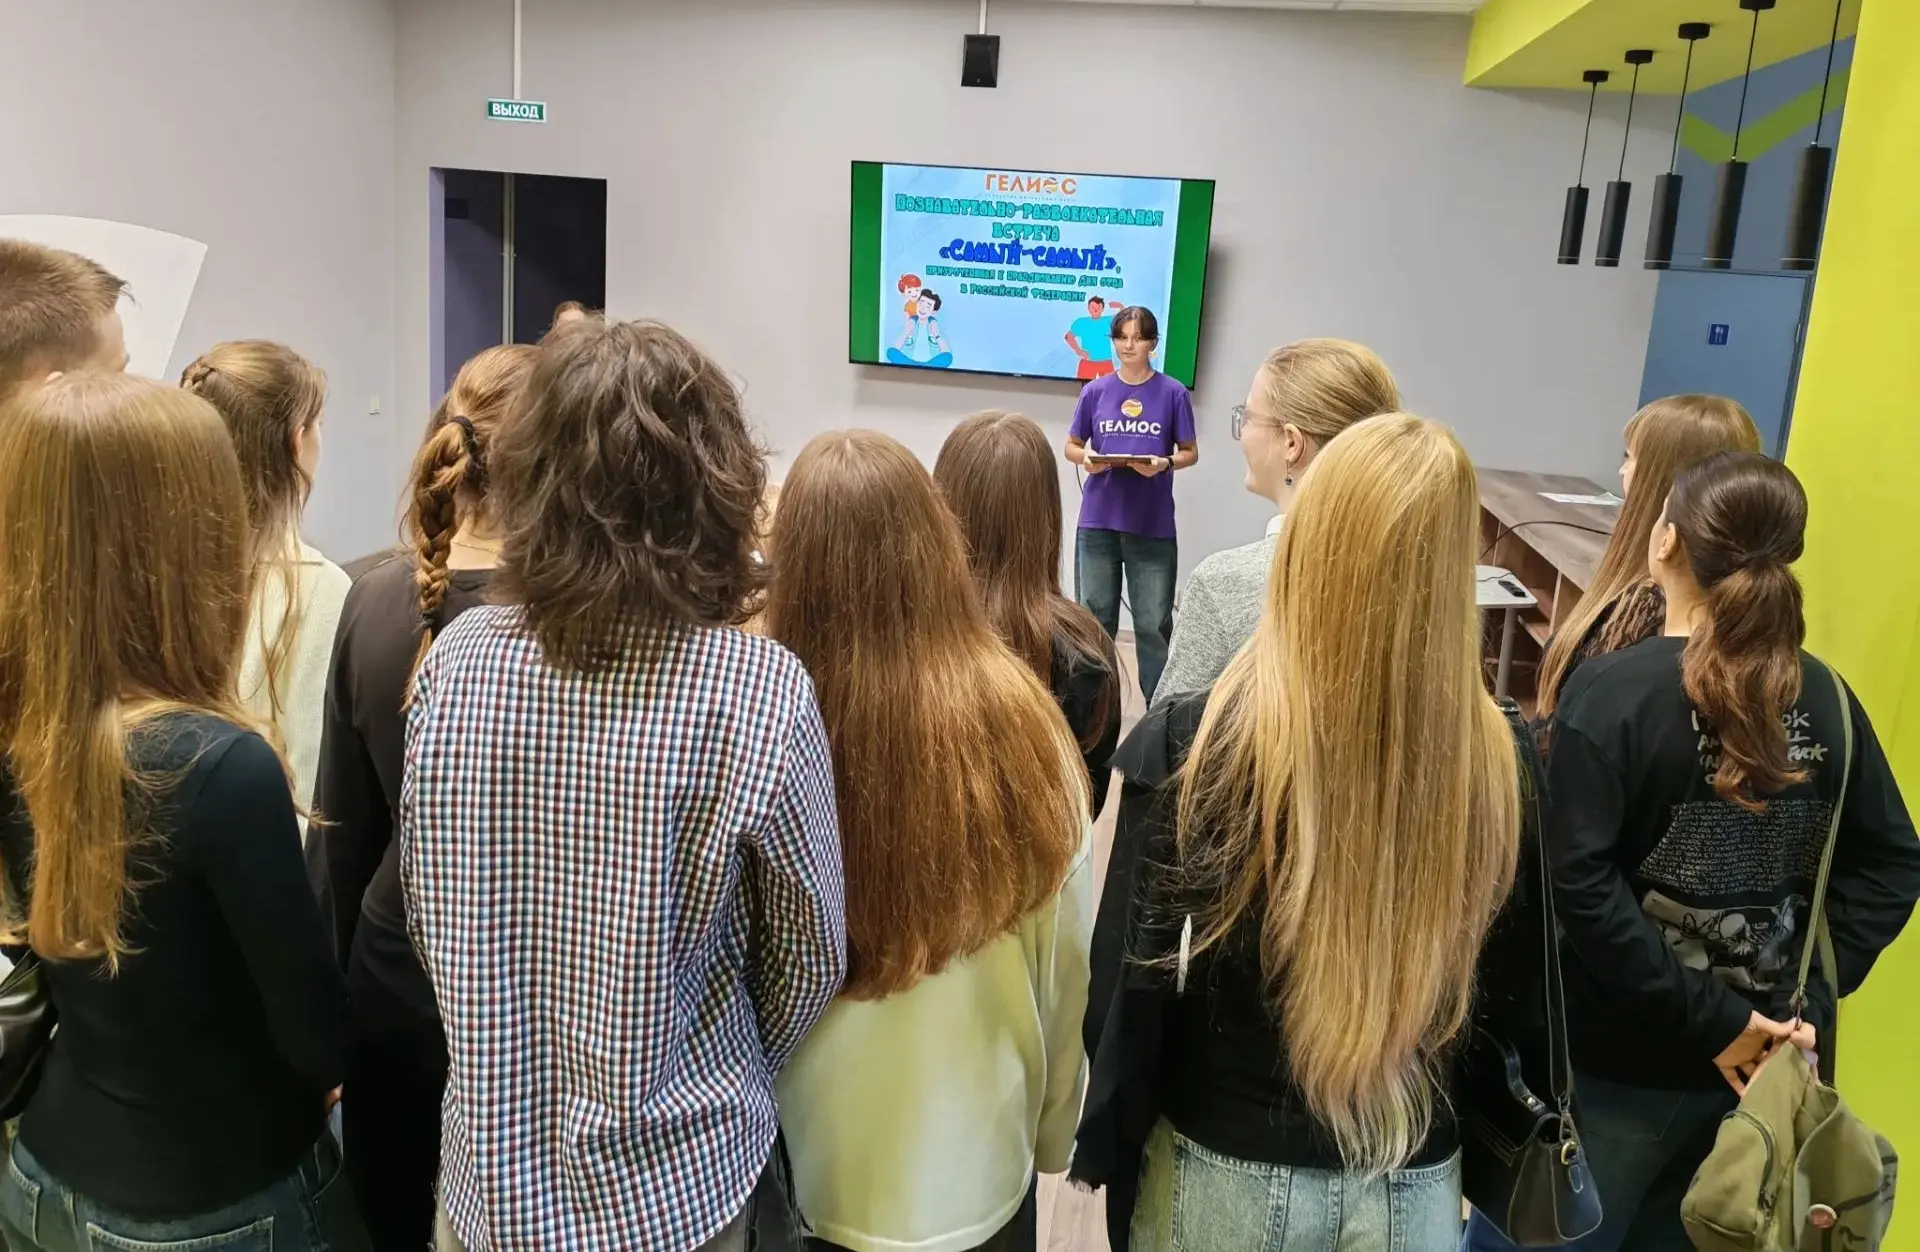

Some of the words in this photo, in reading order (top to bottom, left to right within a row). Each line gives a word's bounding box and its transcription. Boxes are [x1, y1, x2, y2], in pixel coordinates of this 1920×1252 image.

[492, 102, 540, 119] ВЫХОД
[985, 173, 1078, 196] ГЕЛИОС
[991, 221, 1060, 242] ВСТРЕЧА
[1099, 419, 1162, 435] ГЕЛИОС
